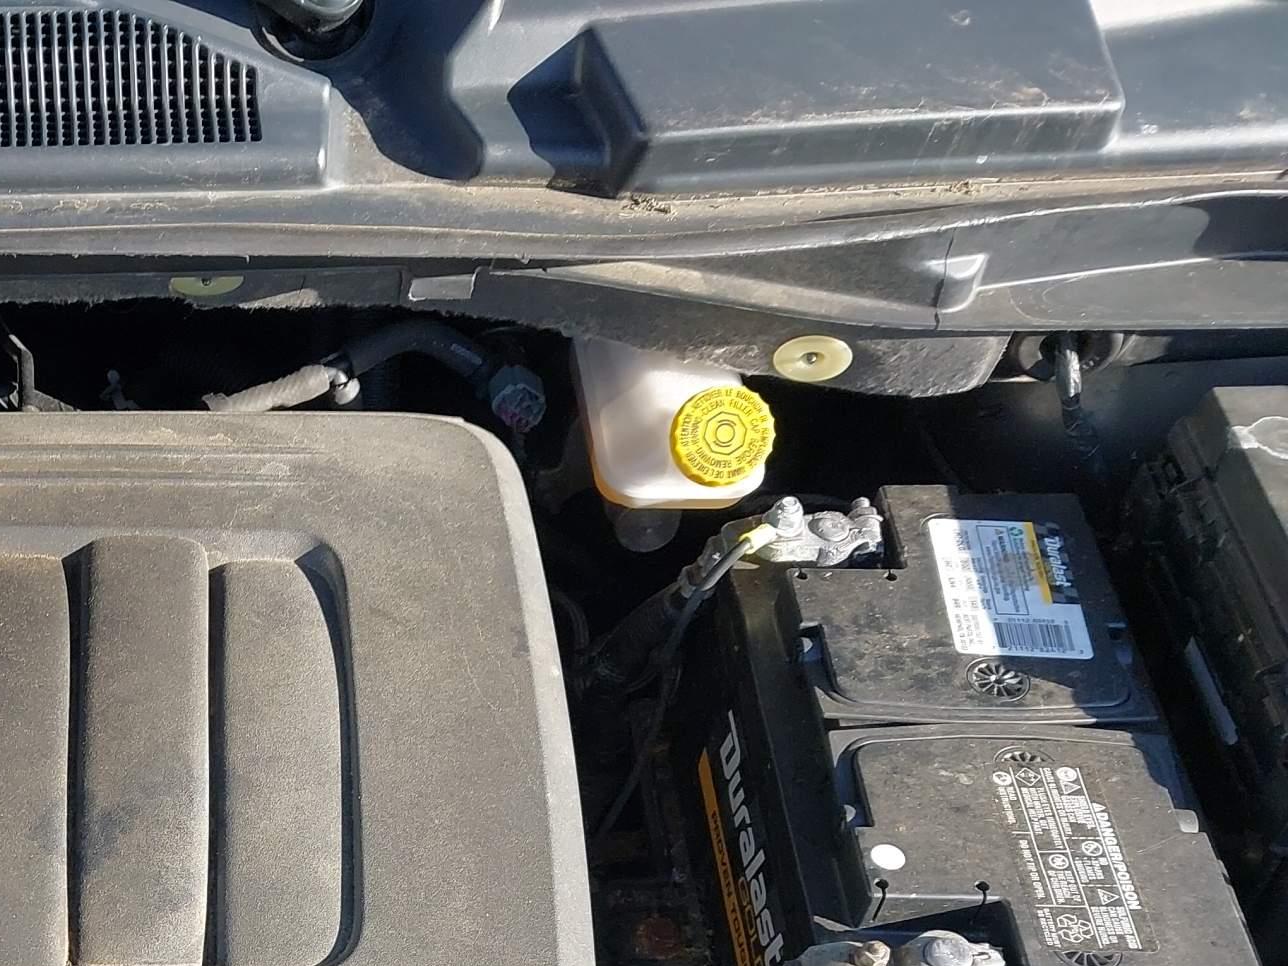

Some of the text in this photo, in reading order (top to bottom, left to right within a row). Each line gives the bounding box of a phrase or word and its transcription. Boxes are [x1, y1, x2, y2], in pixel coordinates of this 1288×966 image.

[1044, 535, 1072, 588] Duralast
[711, 810, 733, 898] PROVEN
[1018, 839, 1030, 848] DO
[1021, 849, 1034, 861] NOT
[1094, 812, 1142, 909] DANGER/POISON
